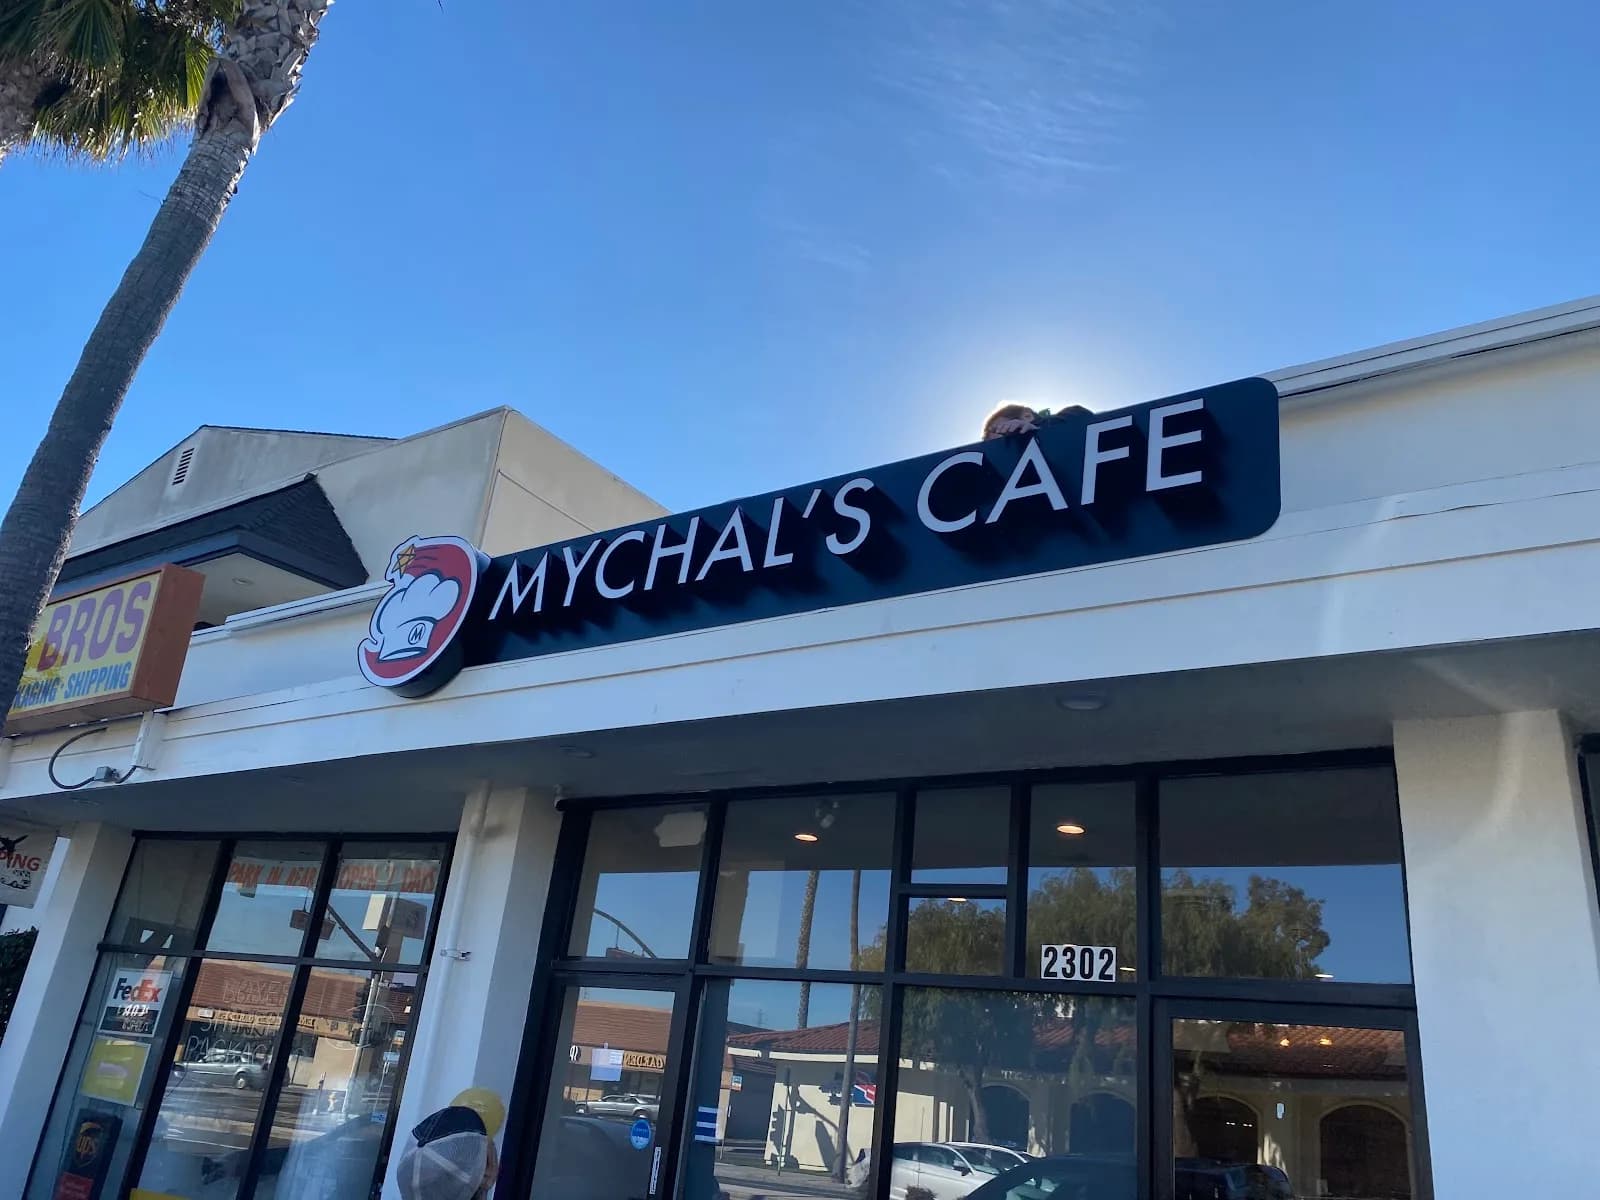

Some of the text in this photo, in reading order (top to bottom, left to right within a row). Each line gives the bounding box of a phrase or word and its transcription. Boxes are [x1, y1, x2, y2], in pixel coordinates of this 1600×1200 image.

[487, 398, 1204, 620] MYCHAL'S CAFE
[37, 581, 152, 672] BROS
[410, 628, 423, 641] M
[64, 661, 133, 699] SHIPPING
[1043, 946, 1114, 980] 2302
[112, 977, 163, 1003] FedEx
